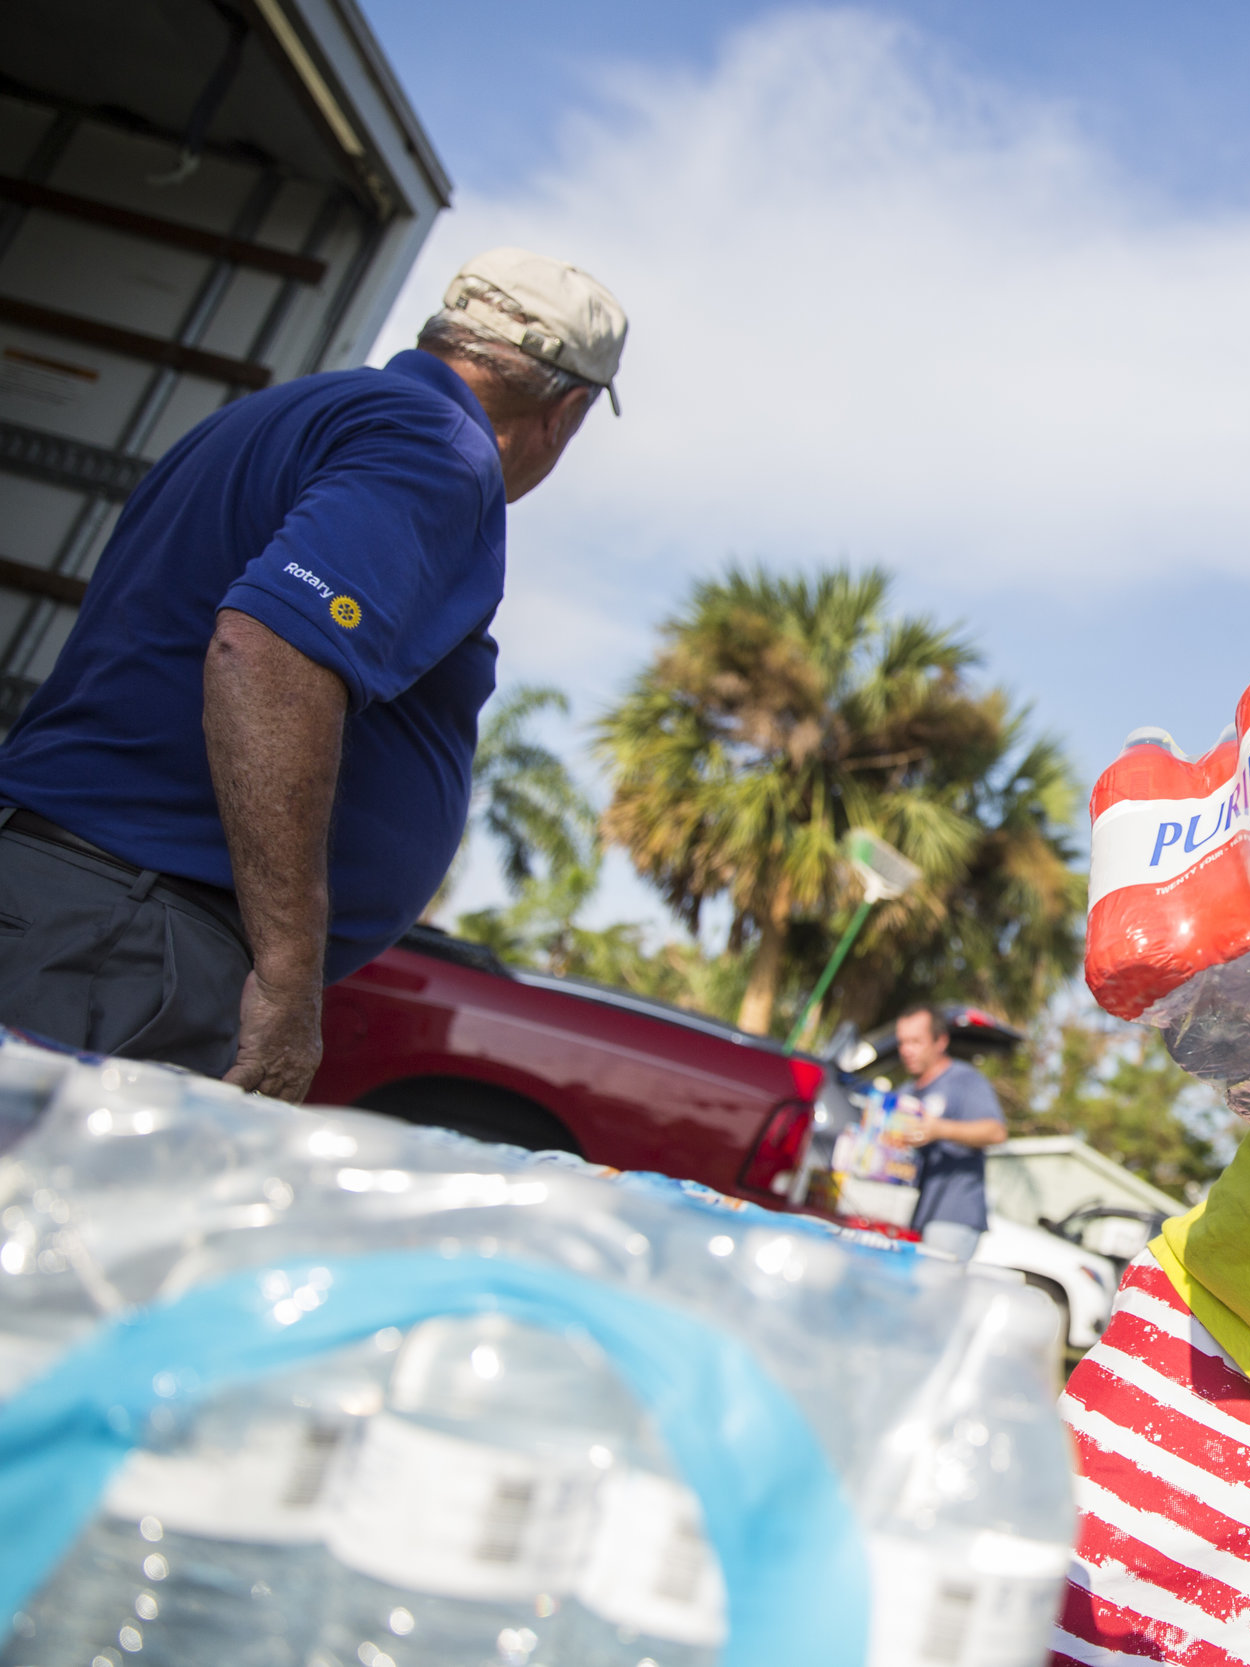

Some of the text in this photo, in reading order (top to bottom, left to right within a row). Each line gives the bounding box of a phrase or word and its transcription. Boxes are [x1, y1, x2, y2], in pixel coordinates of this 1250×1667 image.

[283, 562, 334, 599] Rotary
[1155, 866, 1198, 895] TWENTY
[1199, 849, 1224, 869] FOUR
